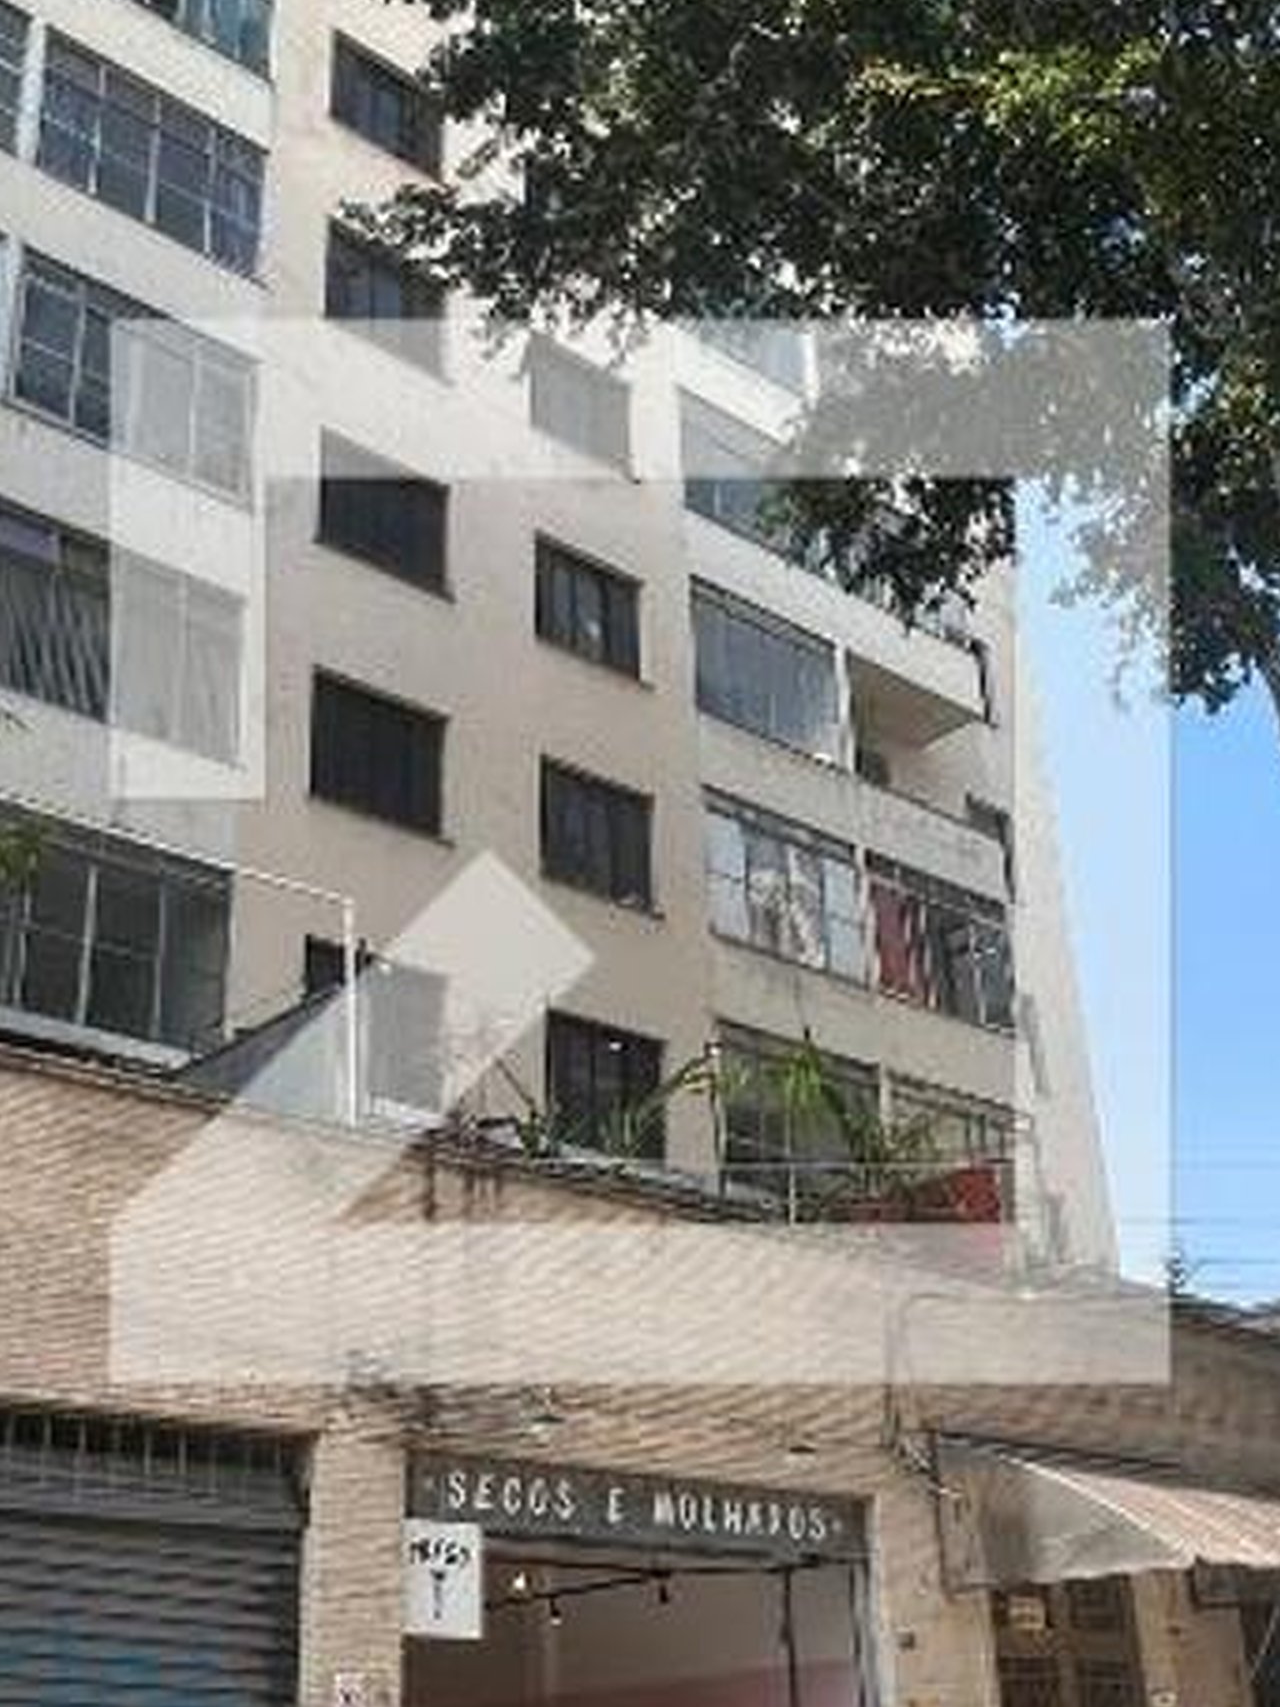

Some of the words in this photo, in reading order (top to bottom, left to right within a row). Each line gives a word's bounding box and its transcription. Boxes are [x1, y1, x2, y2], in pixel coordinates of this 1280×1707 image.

[447, 1469, 576, 1521] SECOS
[607, 1487, 625, 1524] E
[653, 1492, 827, 1541] MOLHADOS
